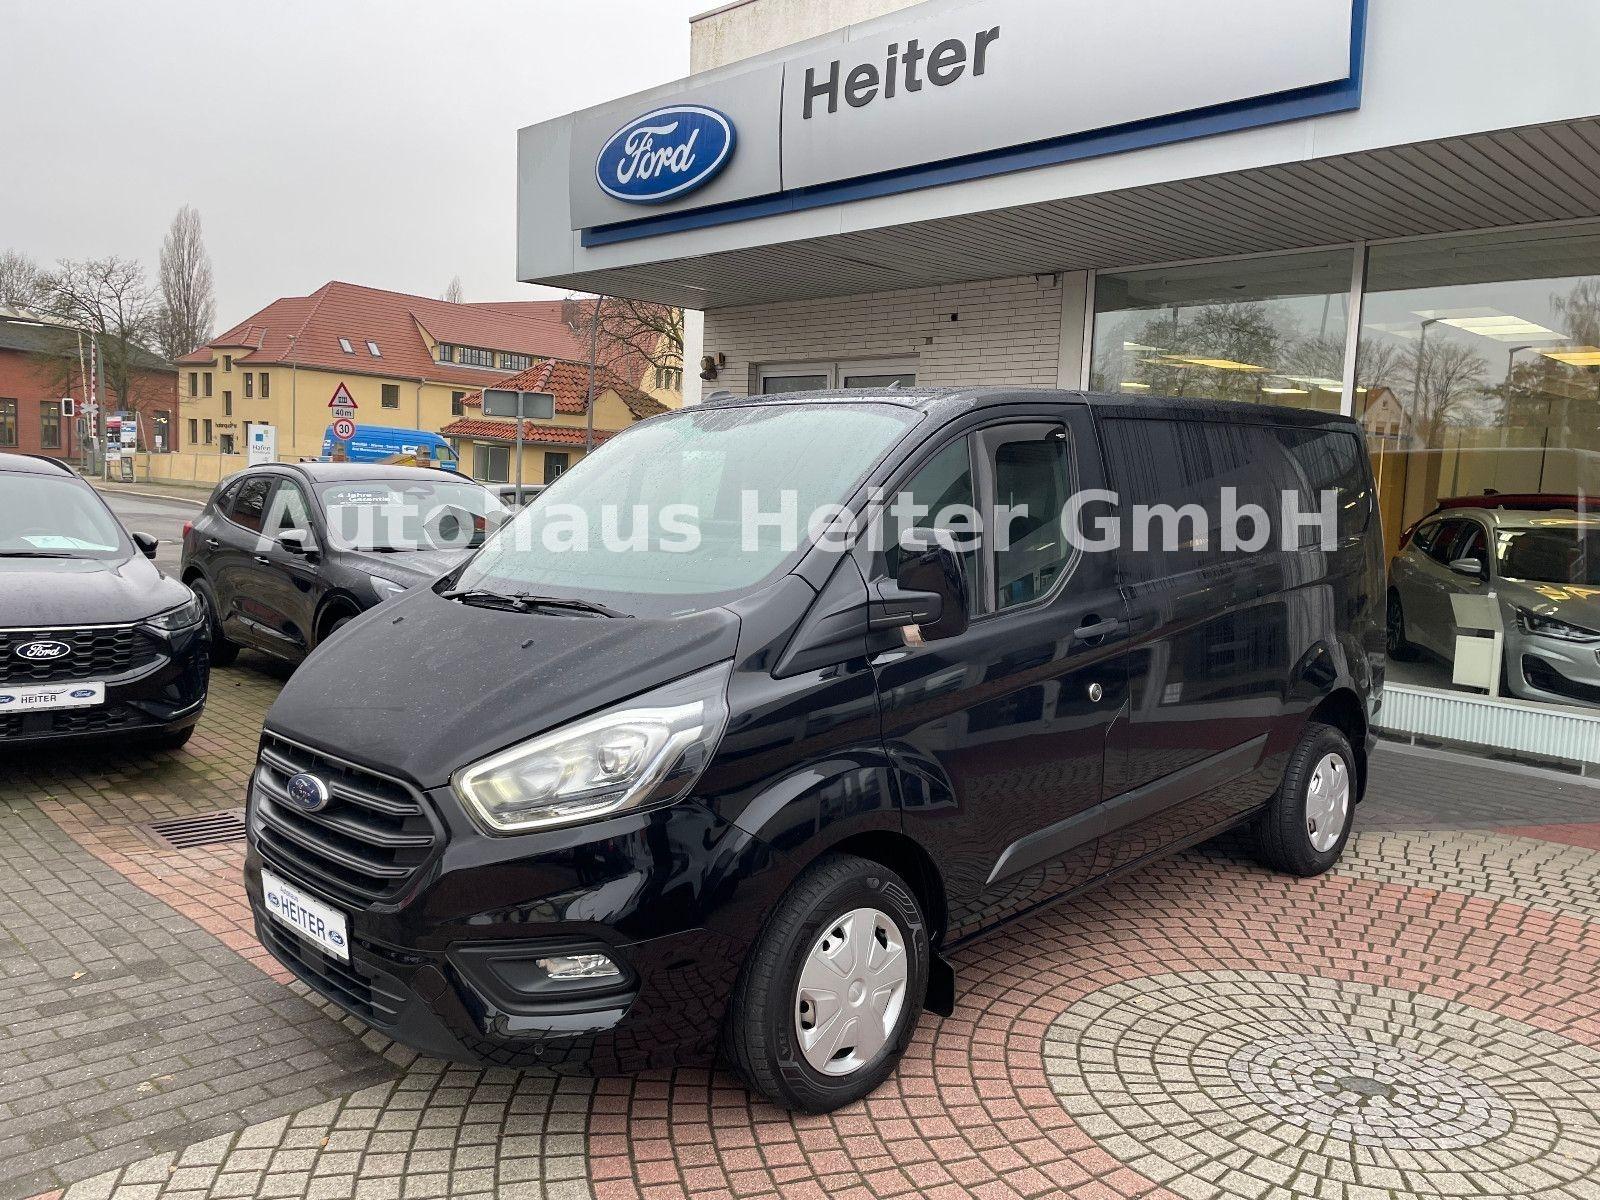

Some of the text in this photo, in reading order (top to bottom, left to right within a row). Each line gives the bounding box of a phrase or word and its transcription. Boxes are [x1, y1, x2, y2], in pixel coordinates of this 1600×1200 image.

[803, 26, 1000, 119] Heiter
[616, 121, 700, 184] Ford
[336, 408, 344, 416] 40
[338, 424, 349, 434] 30
[26, 643, 61, 657] Ford
[21, 694, 57, 704] HEITER
[74, 690, 92, 698] Ford
[280, 895, 327, 942] HEITER
